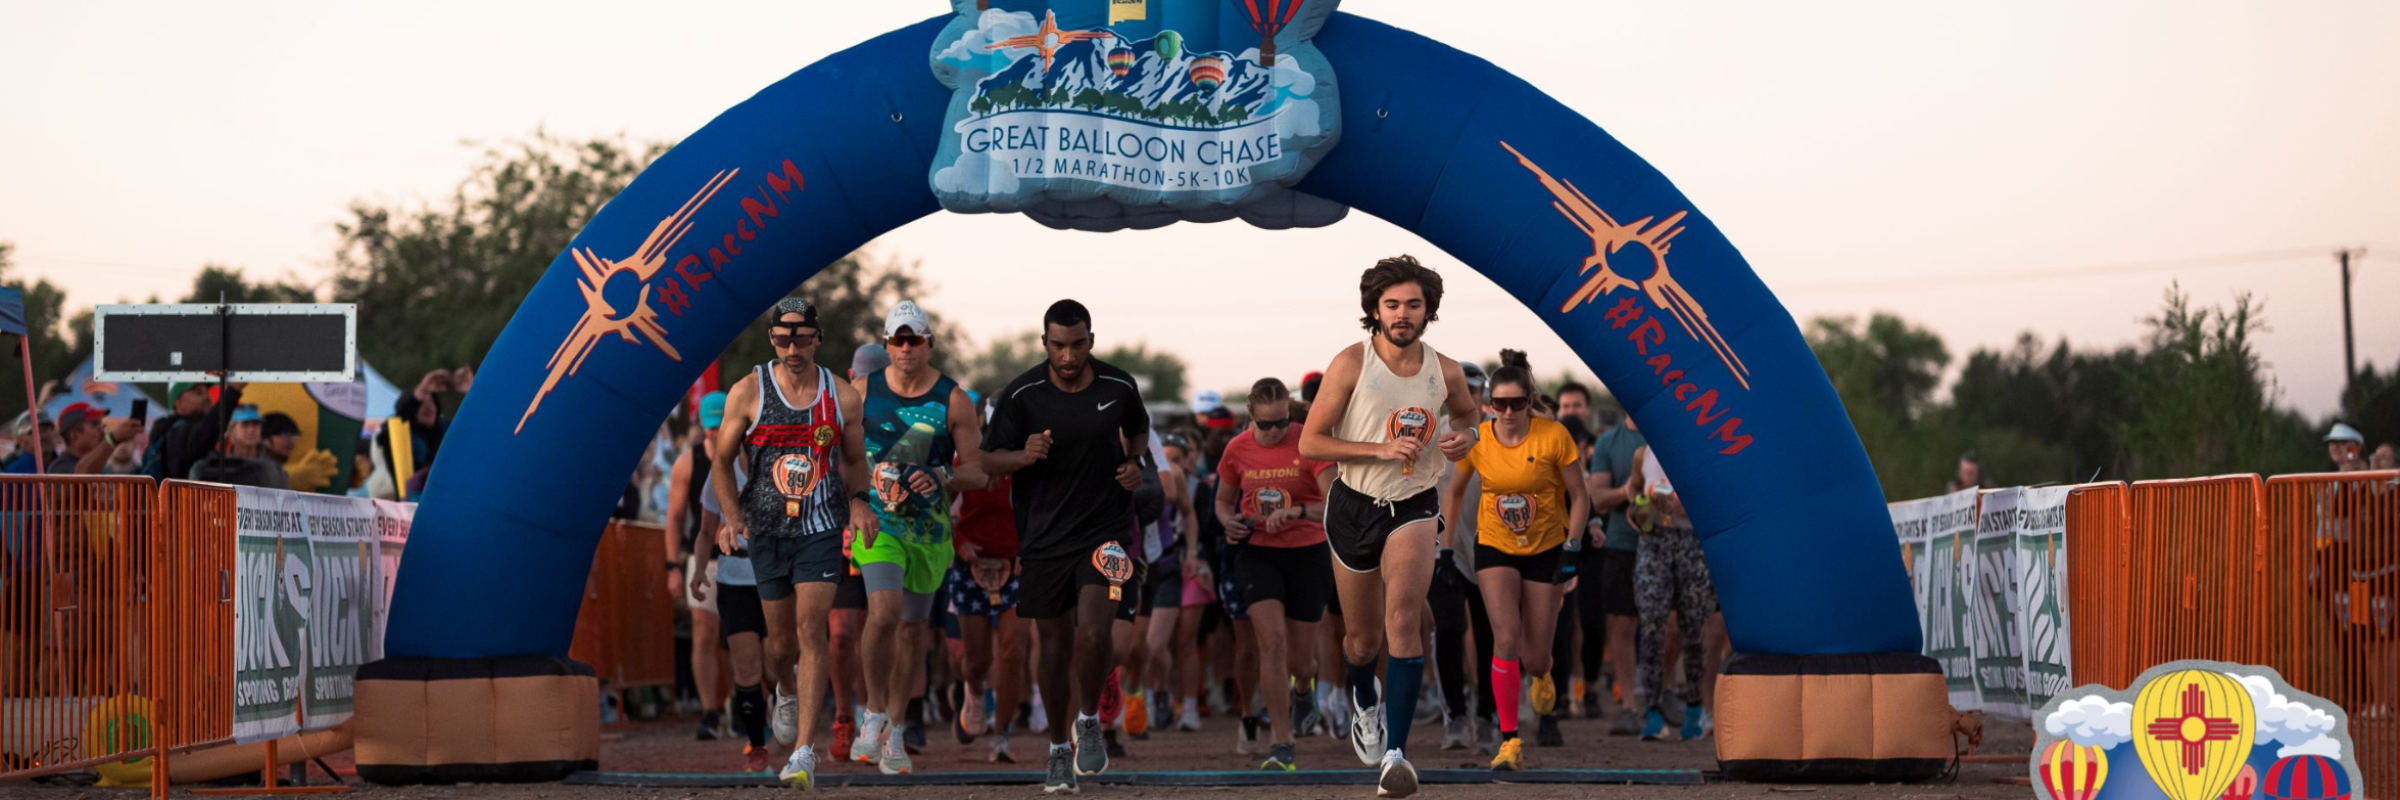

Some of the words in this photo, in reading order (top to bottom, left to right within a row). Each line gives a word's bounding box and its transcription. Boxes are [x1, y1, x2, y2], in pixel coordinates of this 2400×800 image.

[967, 125, 1049, 153] GREAT
[1059, 126, 1185, 163] BALLOON
[1197, 133, 1279, 166] CHASE
[1013, 157, 1044, 174] 1/2
[1054, 157, 1249, 187] MARATHON-5K-10K
[657, 158, 805, 317] #RaceNM
[1603, 296, 1754, 455] #RaceNM
[787, 470, 805, 489] 89
[1244, 467, 1299, 480] MILESTONE
[291, 512, 303, 533] AT
[321, 515, 346, 537] SEASON
[314, 674, 353, 701] SPORTING
